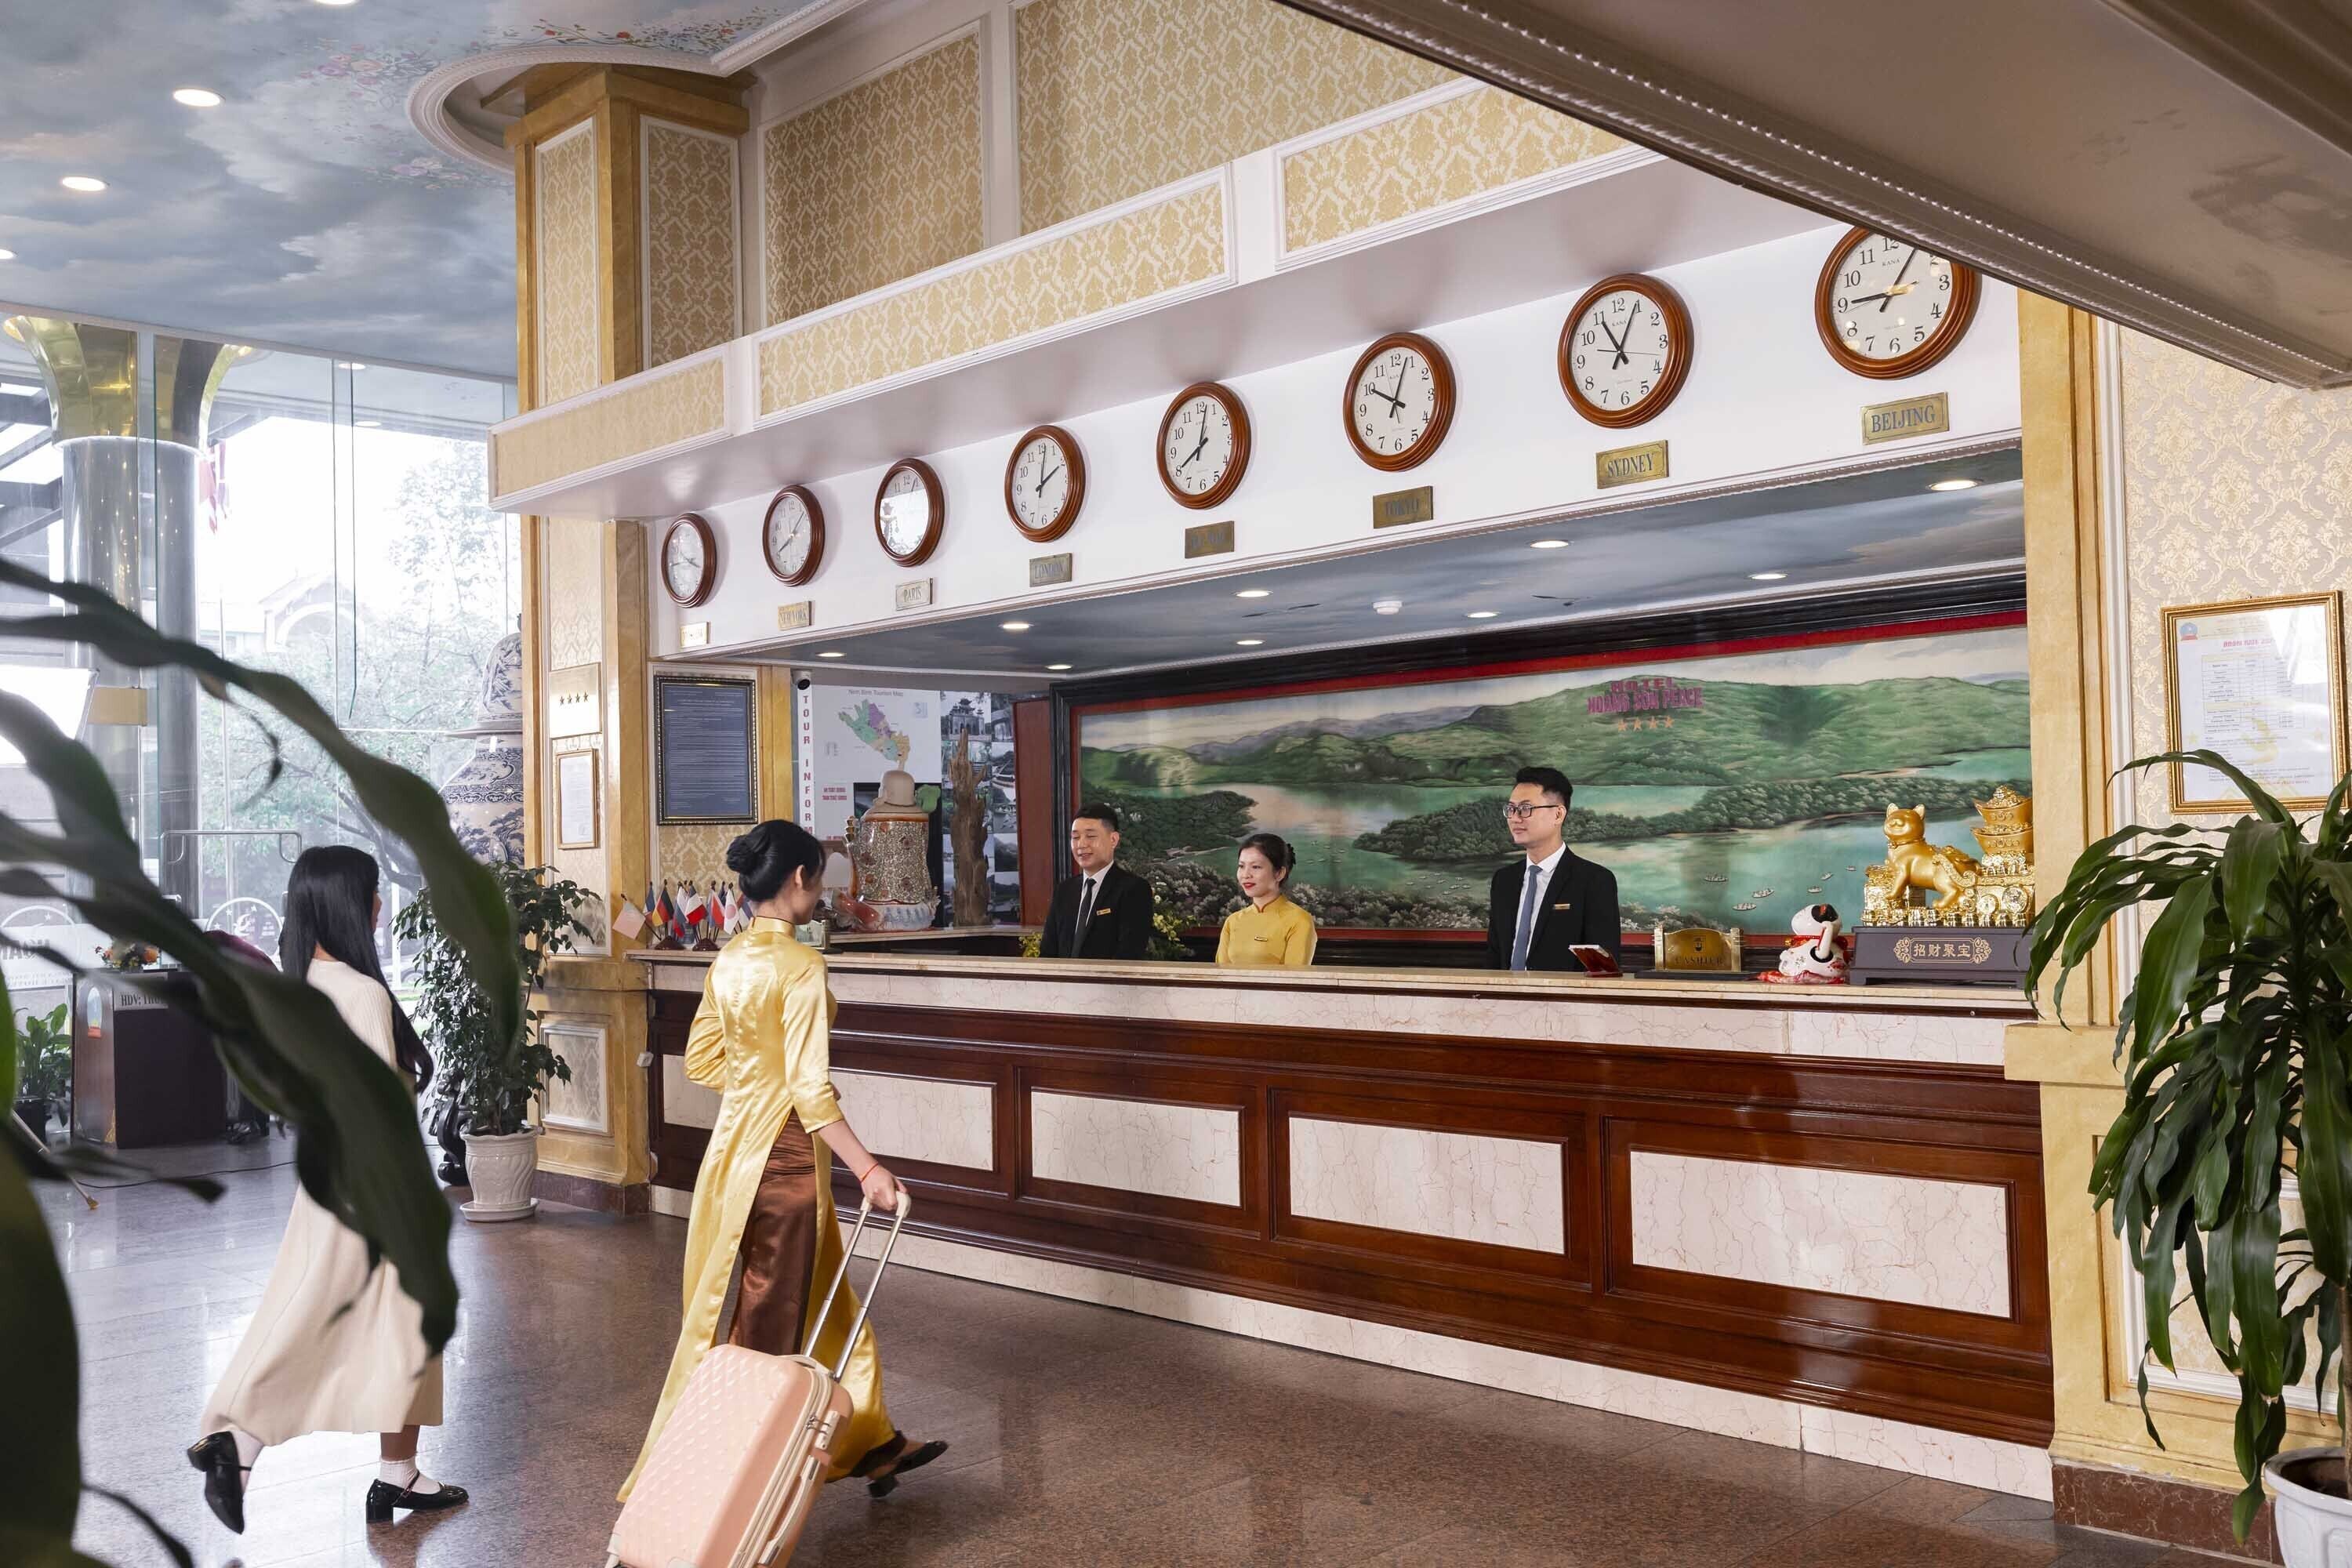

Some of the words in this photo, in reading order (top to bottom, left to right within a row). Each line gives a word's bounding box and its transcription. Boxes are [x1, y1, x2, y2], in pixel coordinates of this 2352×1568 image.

[1882, 238, 1900, 252] 12
[1859, 249, 1875, 265] 11
[1844, 270, 1860, 288] 10
[1939, 274, 1950, 290] 3
[1612, 298, 1624, 313] 12
[1838, 298, 1848, 313] 9
[1931, 303, 1942, 318] 4
[1593, 310, 1605, 325] 11
[1651, 312, 1660, 325] 2
[1847, 321, 1857, 336] 8
[1914, 326, 1925, 342] 5
[1581, 330, 1595, 346] 10
[1659, 335, 1668, 348] 3
[1865, 336, 1875, 351] 7
[1889, 338, 1900, 353] 6
[1390, 354, 1401, 367] 12
[1409, 356, 1415, 368] 1
[1577, 355, 1585, 368] 9
[1653, 359, 1662, 374] 4
[1374, 365, 1385, 378] 11
[1421, 368, 1428, 379] 2
[1364, 383, 1375, 396] 10
[1585, 376, 1594, 390] 8
[1640, 380, 1649, 394] 5
[1428, 388, 1435, 401] 3
[1601, 390, 1609, 404] 7
[1621, 391, 1630, 405] 6
[1196, 401, 1205, 414] 12
[1212, 405, 1217, 415] 1
[1359, 404, 1367, 416] 9
[1182, 412, 1192, 423] 11
[1222, 415, 1229, 426] 2
[1422, 411, 1430, 423] 4
[1871, 405, 1936, 433] BEIJING
[1174, 427, 1183, 440] 10
[1366, 423, 1373, 436] 8
[1411, 430, 1418, 442] 5
[1379, 437, 1385, 449] 7
[1395, 438, 1402, 451] 6
[1051, 445, 1055, 456] 1
[1171, 447, 1176, 459] 9
[1027, 452, 1035, 463] 11
[1223, 454, 1229, 466] 4
[1020, 466, 1028, 477] 10
[1176, 465, 1181, 477] 8
[1607, 453, 1654, 477] SYDNEY
[903, 475, 910, 485] 12
[1186, 477, 1192, 488] 7
[1214, 471, 1219, 483] 5
[895, 482, 900, 492] 11
[1017, 484, 1022, 495] 9
[1200, 479, 1206, 490] 6
[1021, 502, 1026, 512] 8
[1054, 508, 1058, 517] 5
[1030, 513, 1035, 523] 7
[1041, 514, 1047, 525] 6
[904, 588, 922, 602] PARIS
[1611, 677, 1673, 692] HOTEL
[1913, 943, 1971, 957] 招财聚宝
[121, 993, 141, 1007] HDV:
